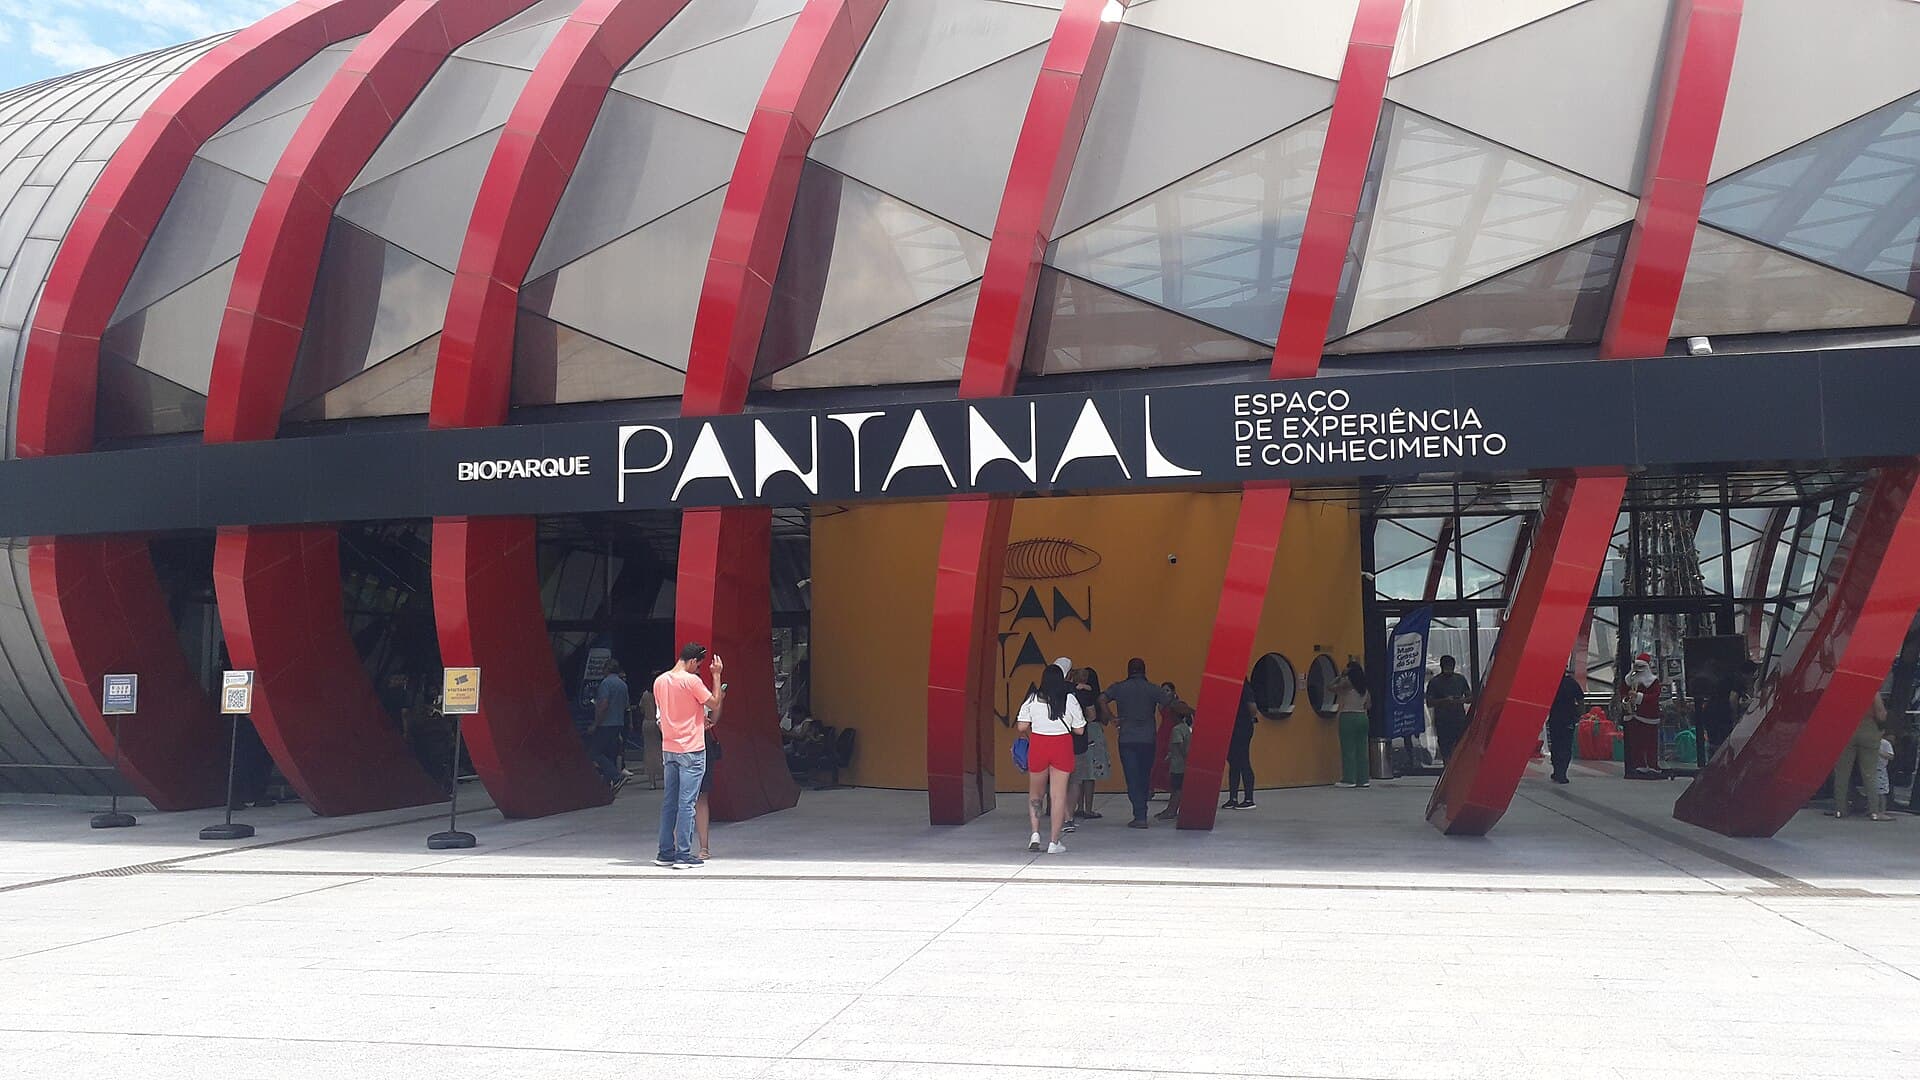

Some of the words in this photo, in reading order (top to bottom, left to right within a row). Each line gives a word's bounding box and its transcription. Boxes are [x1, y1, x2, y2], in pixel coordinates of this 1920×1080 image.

[1234, 389, 1350, 416] ESPAÇO
[1234, 418, 1273, 442] DE
[1283, 406, 1483, 439] EXPERIÊNCIA
[616, 394, 1203, 504] PANTANAL
[1235, 445, 1252, 467] E
[1261, 433, 1507, 466] CONHECIMENTO
[457, 455, 591, 482] BIOPARQUE
